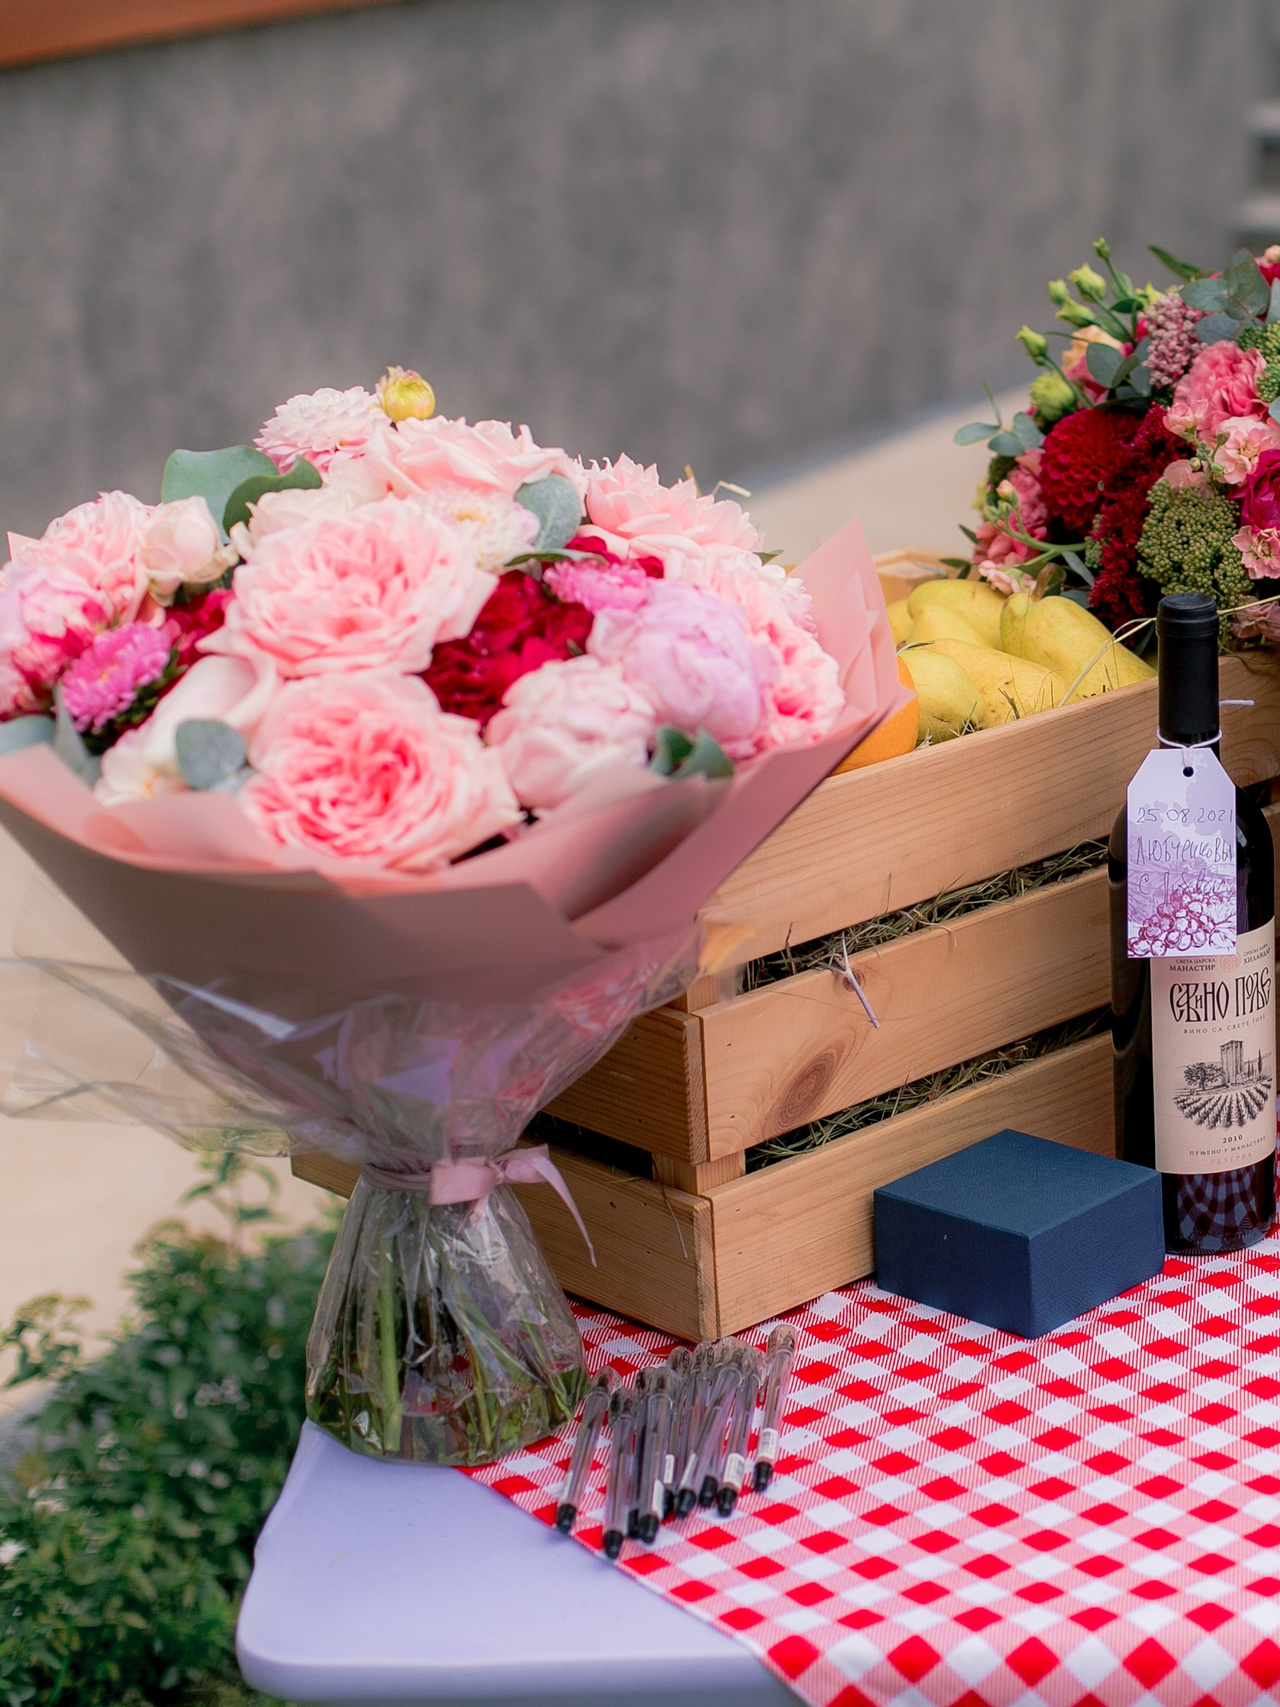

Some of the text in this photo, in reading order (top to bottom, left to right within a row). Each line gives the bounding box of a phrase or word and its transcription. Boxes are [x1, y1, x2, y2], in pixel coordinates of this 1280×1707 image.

[1227, 1020, 1250, 1030] СВЕТЕ
[1222, 1134, 1243, 1144] 2010
[1211, 1152, 1252, 1165] РЕЗЕРВА
